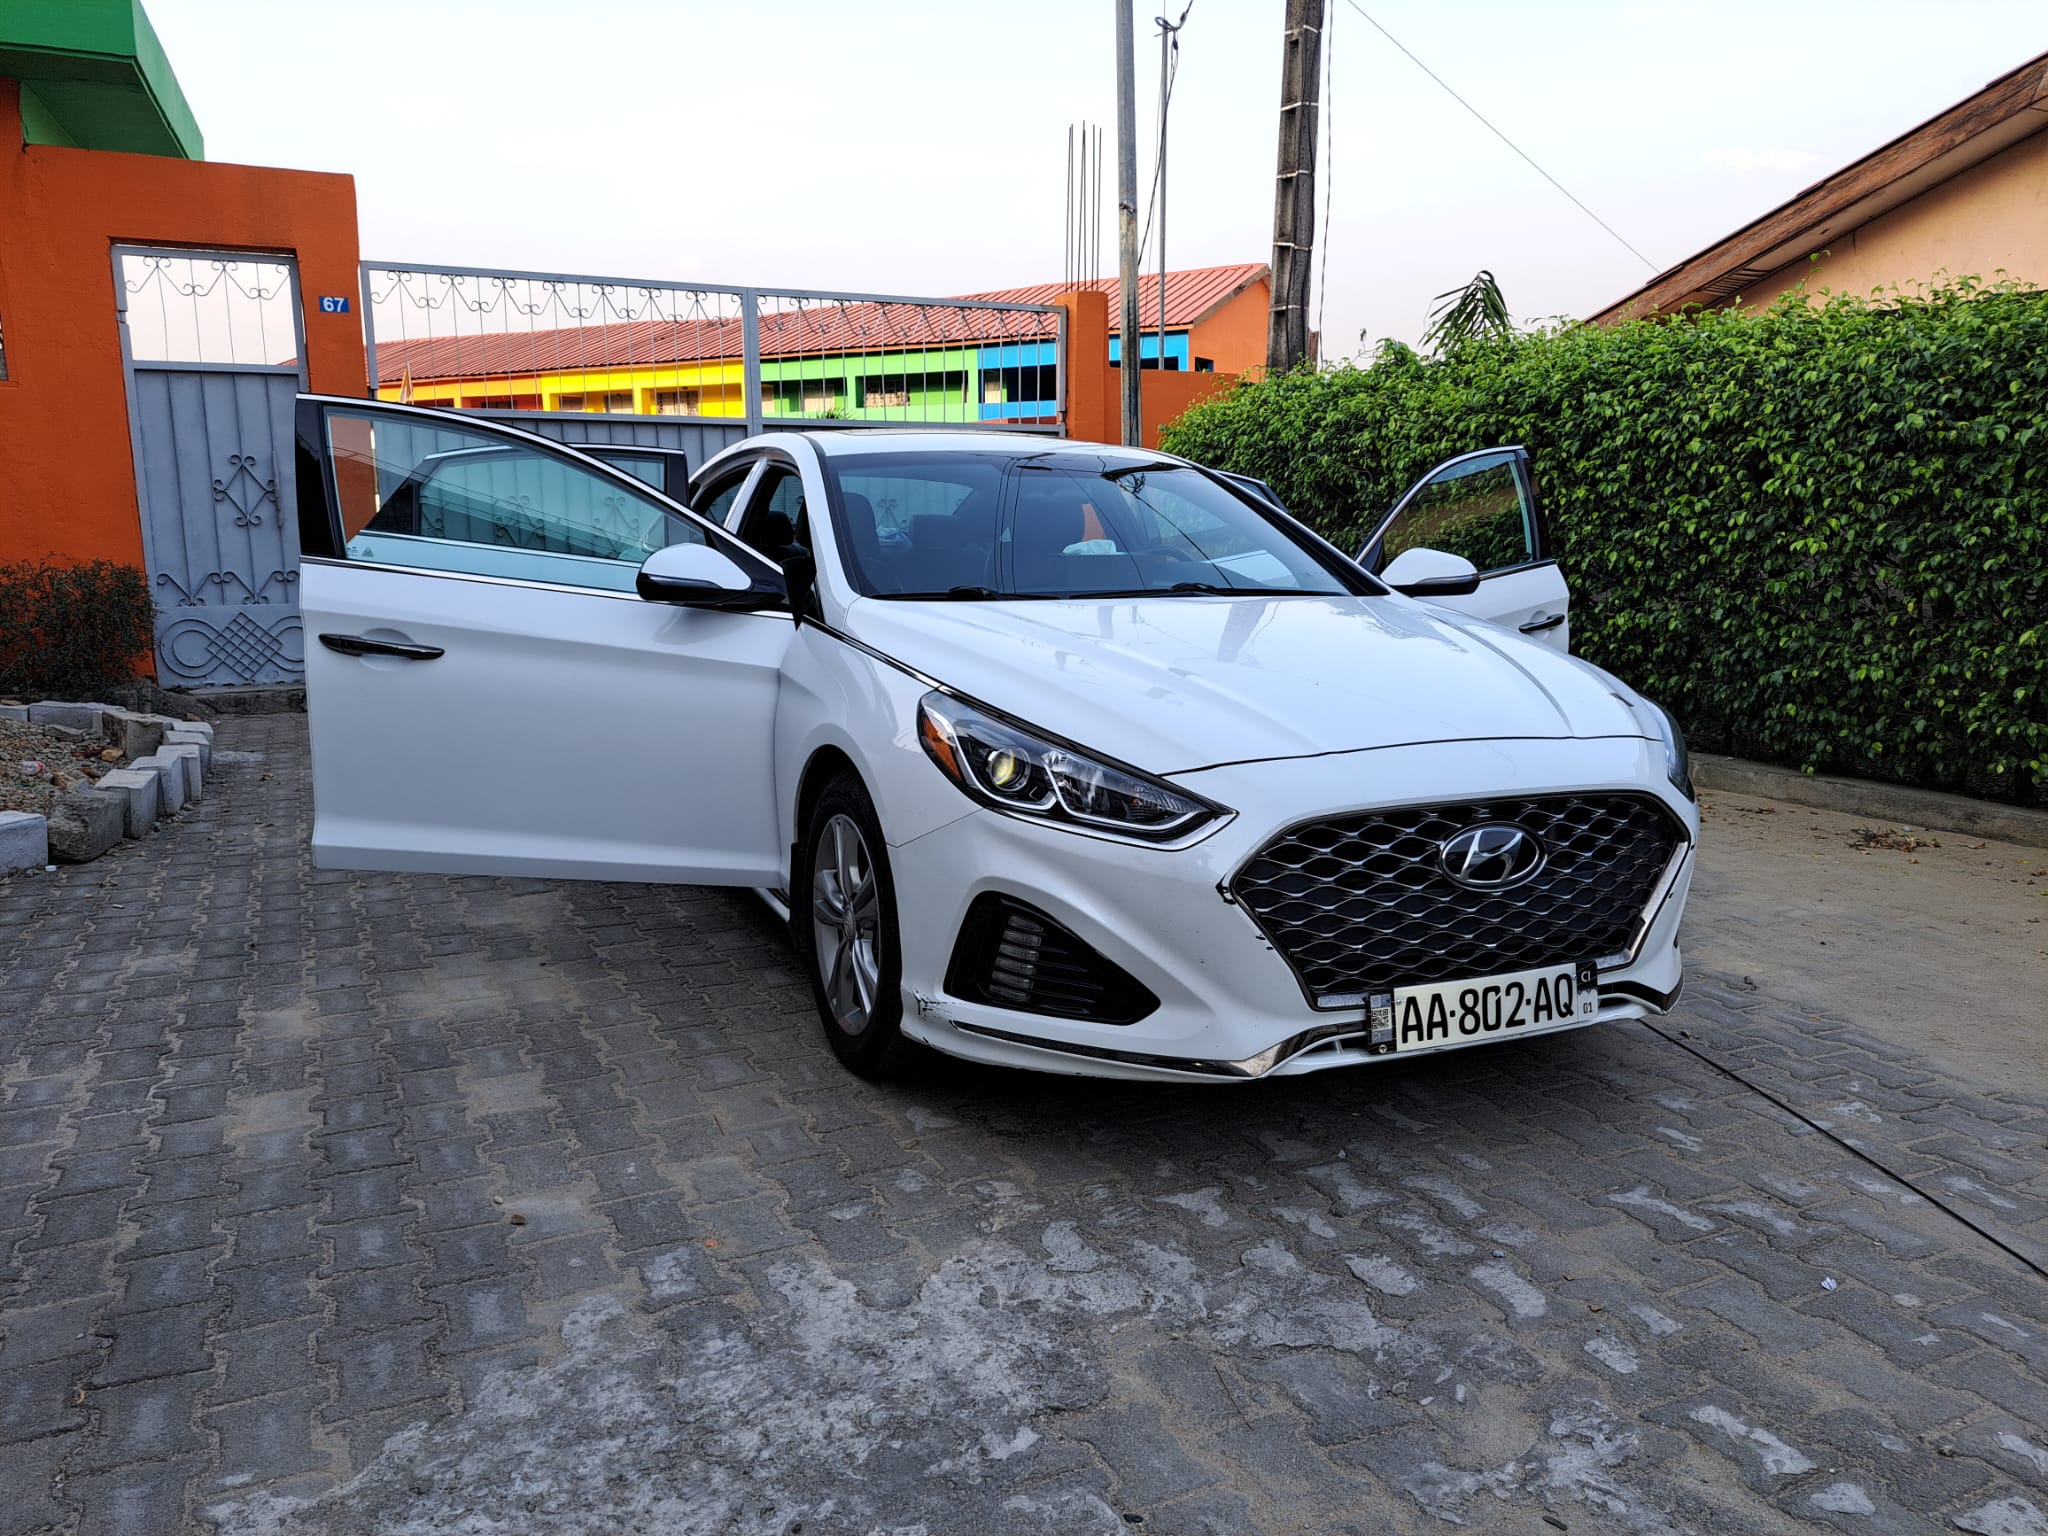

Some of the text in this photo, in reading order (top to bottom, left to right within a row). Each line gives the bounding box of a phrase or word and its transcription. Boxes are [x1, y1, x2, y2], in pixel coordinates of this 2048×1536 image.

[323, 296, 345, 312] 67
[1581, 970, 1591, 982] CI
[1583, 1001, 1593, 1014] 01
